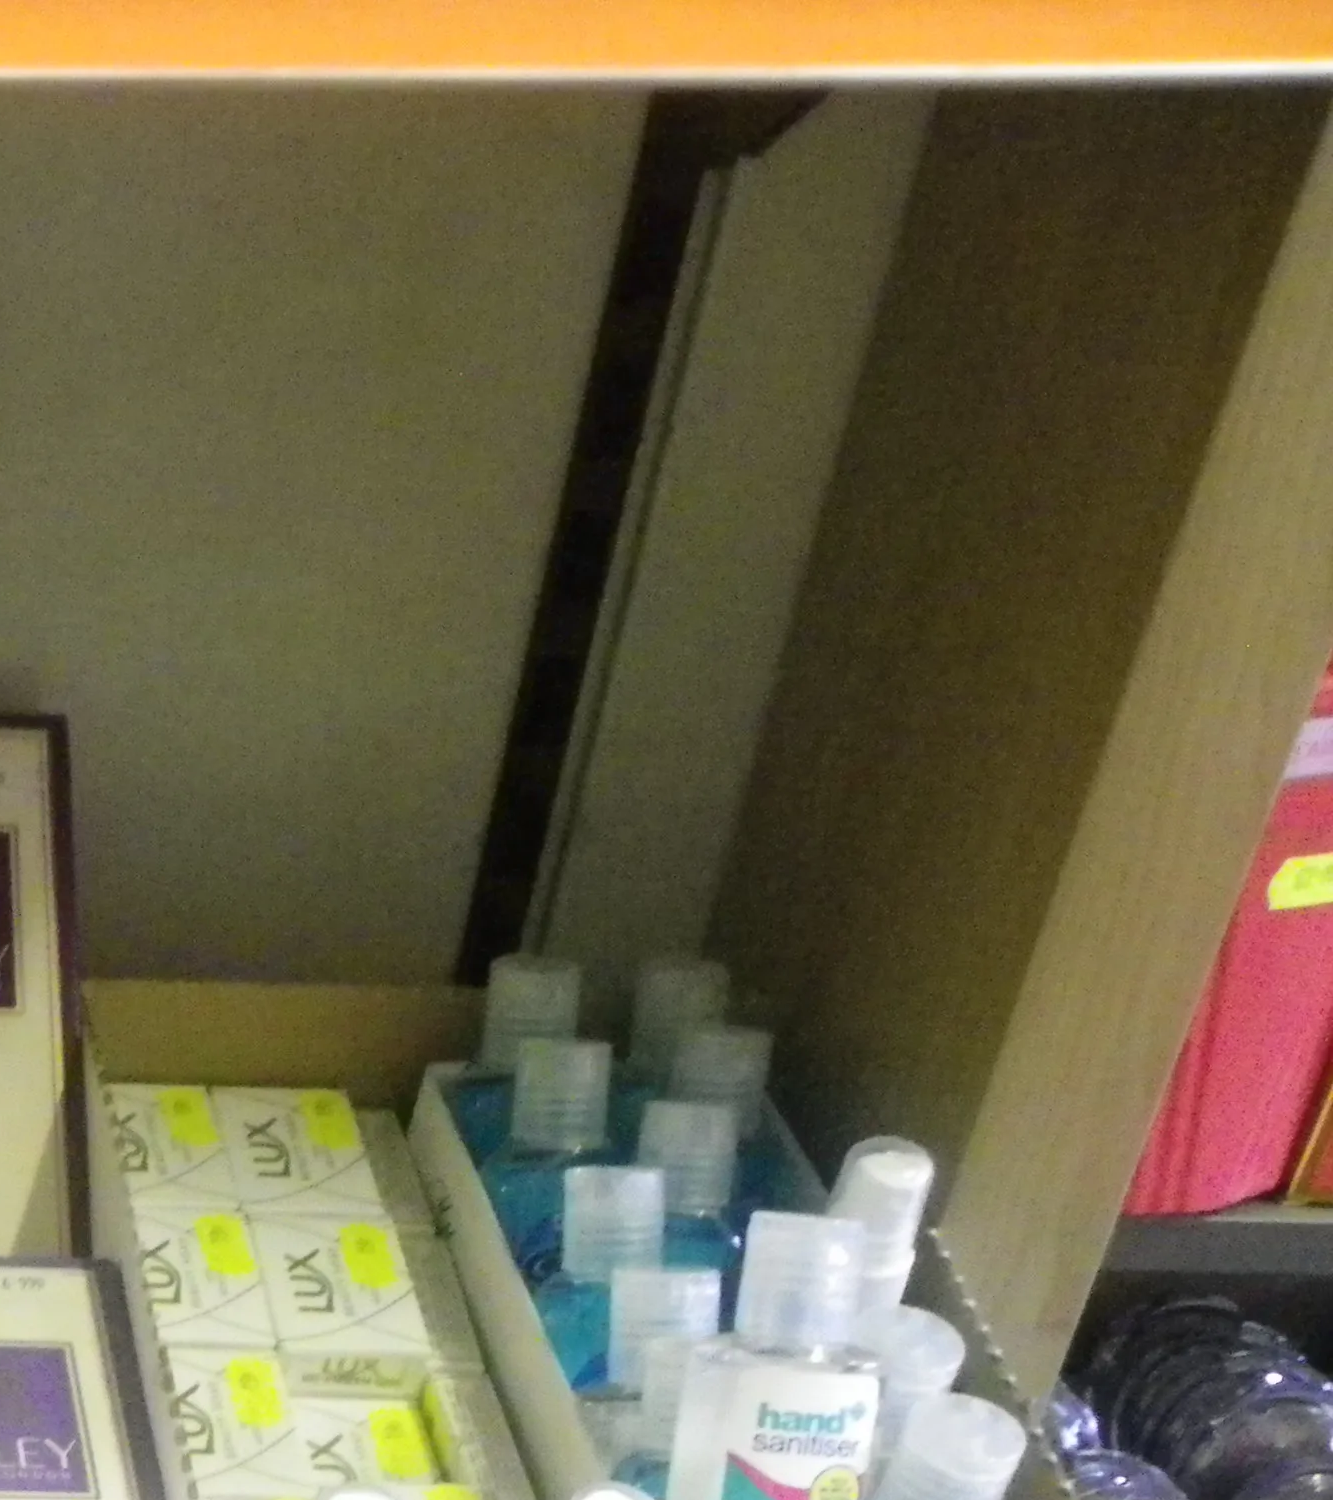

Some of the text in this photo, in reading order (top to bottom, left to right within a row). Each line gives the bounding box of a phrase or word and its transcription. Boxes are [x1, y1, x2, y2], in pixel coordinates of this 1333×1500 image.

[244, 1116, 292, 1179] LUX
[284, 1249, 335, 1314] LUX
[757, 1402, 845, 1434] hand
[752, 1431, 859, 1459] sanitiser
